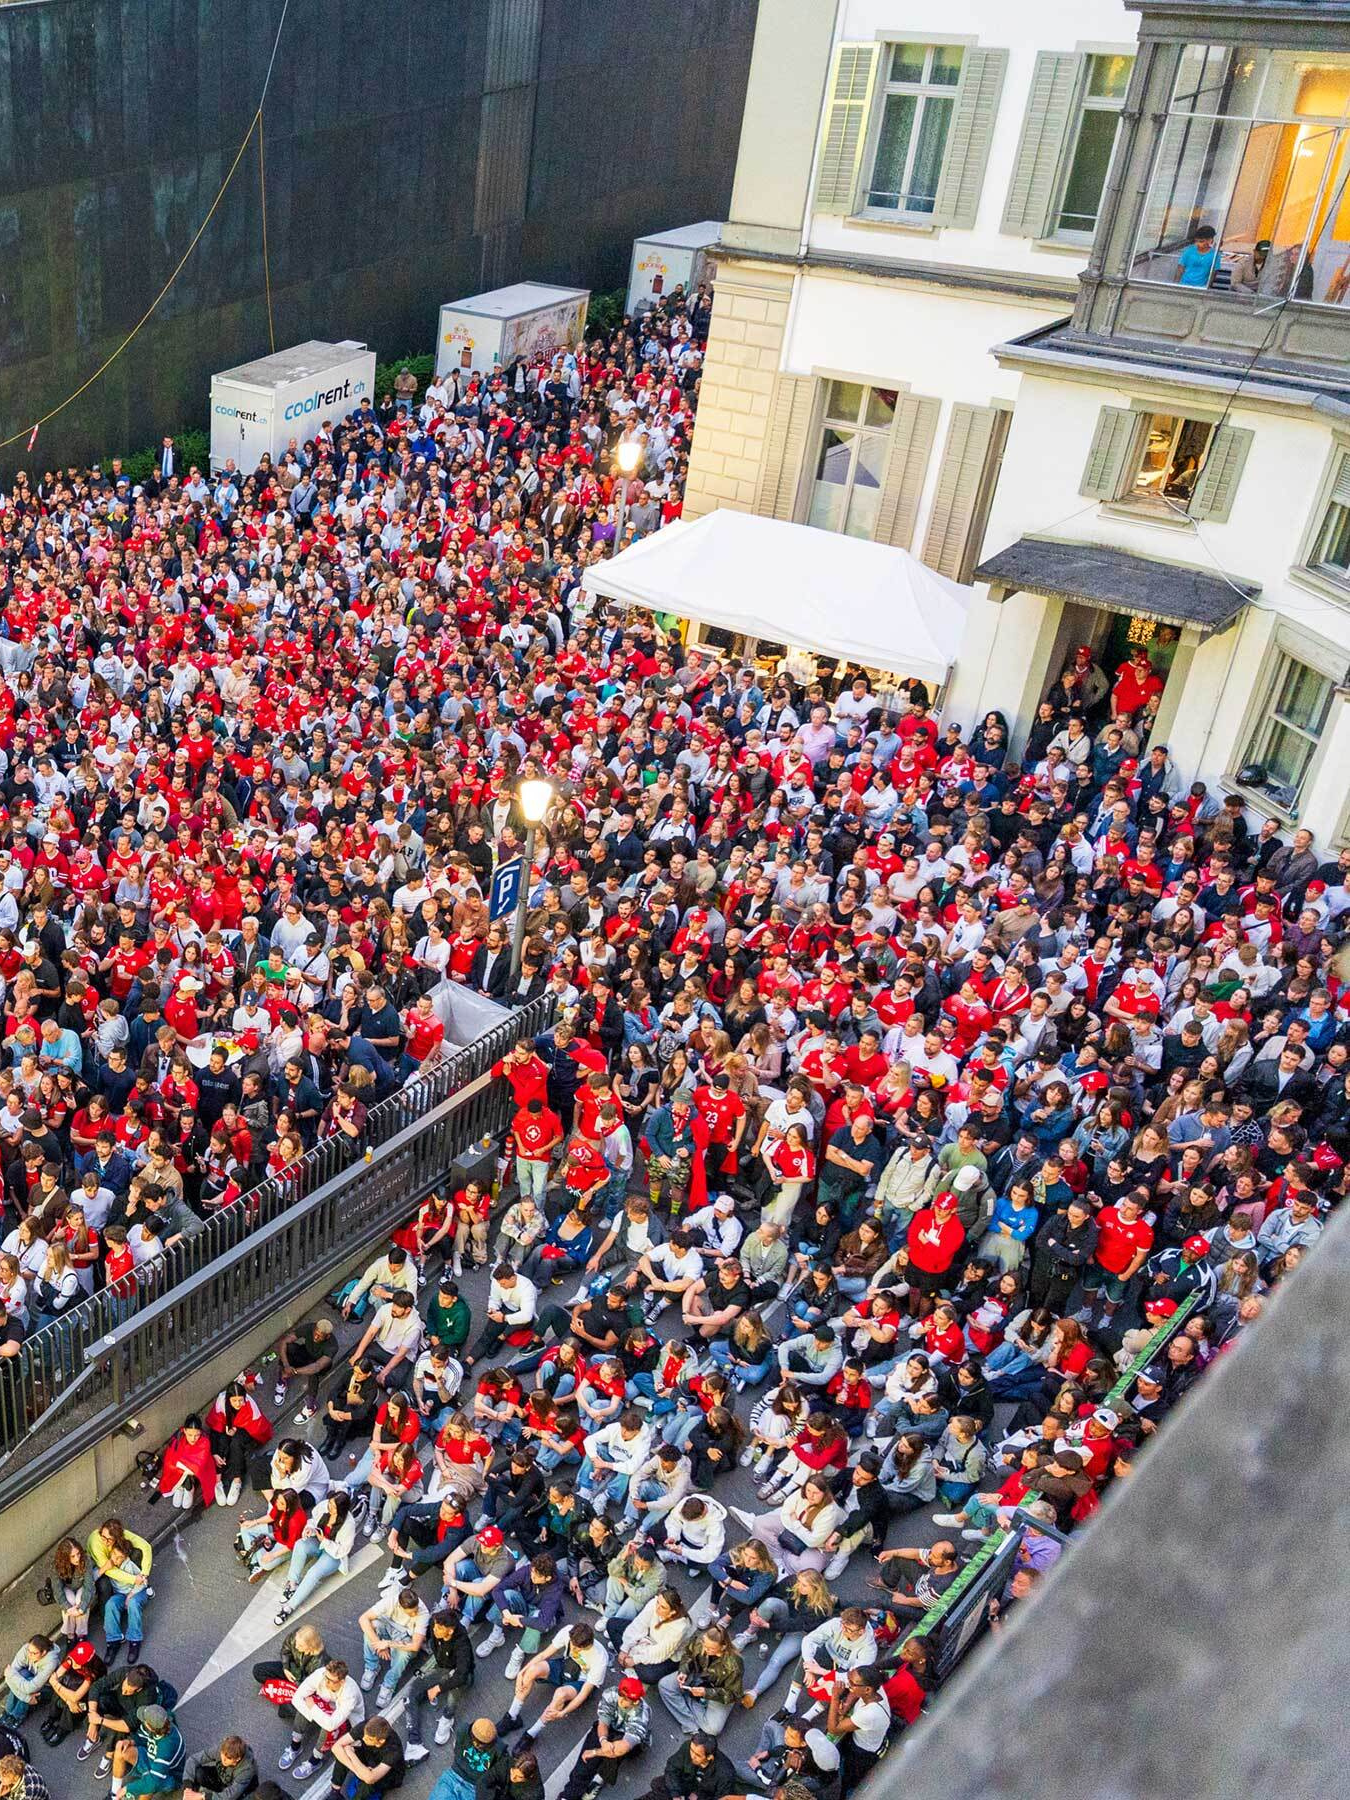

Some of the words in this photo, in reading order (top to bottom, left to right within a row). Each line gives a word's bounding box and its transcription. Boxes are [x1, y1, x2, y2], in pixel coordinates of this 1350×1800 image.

[284, 378, 365, 420] coolrent.ch
[215, 404, 267, 425] coolrent.ch
[498, 874, 513, 904] P
[705, 1111, 718, 1124] 23
[340, 1169, 411, 1223] SCHWEIZERHOF
